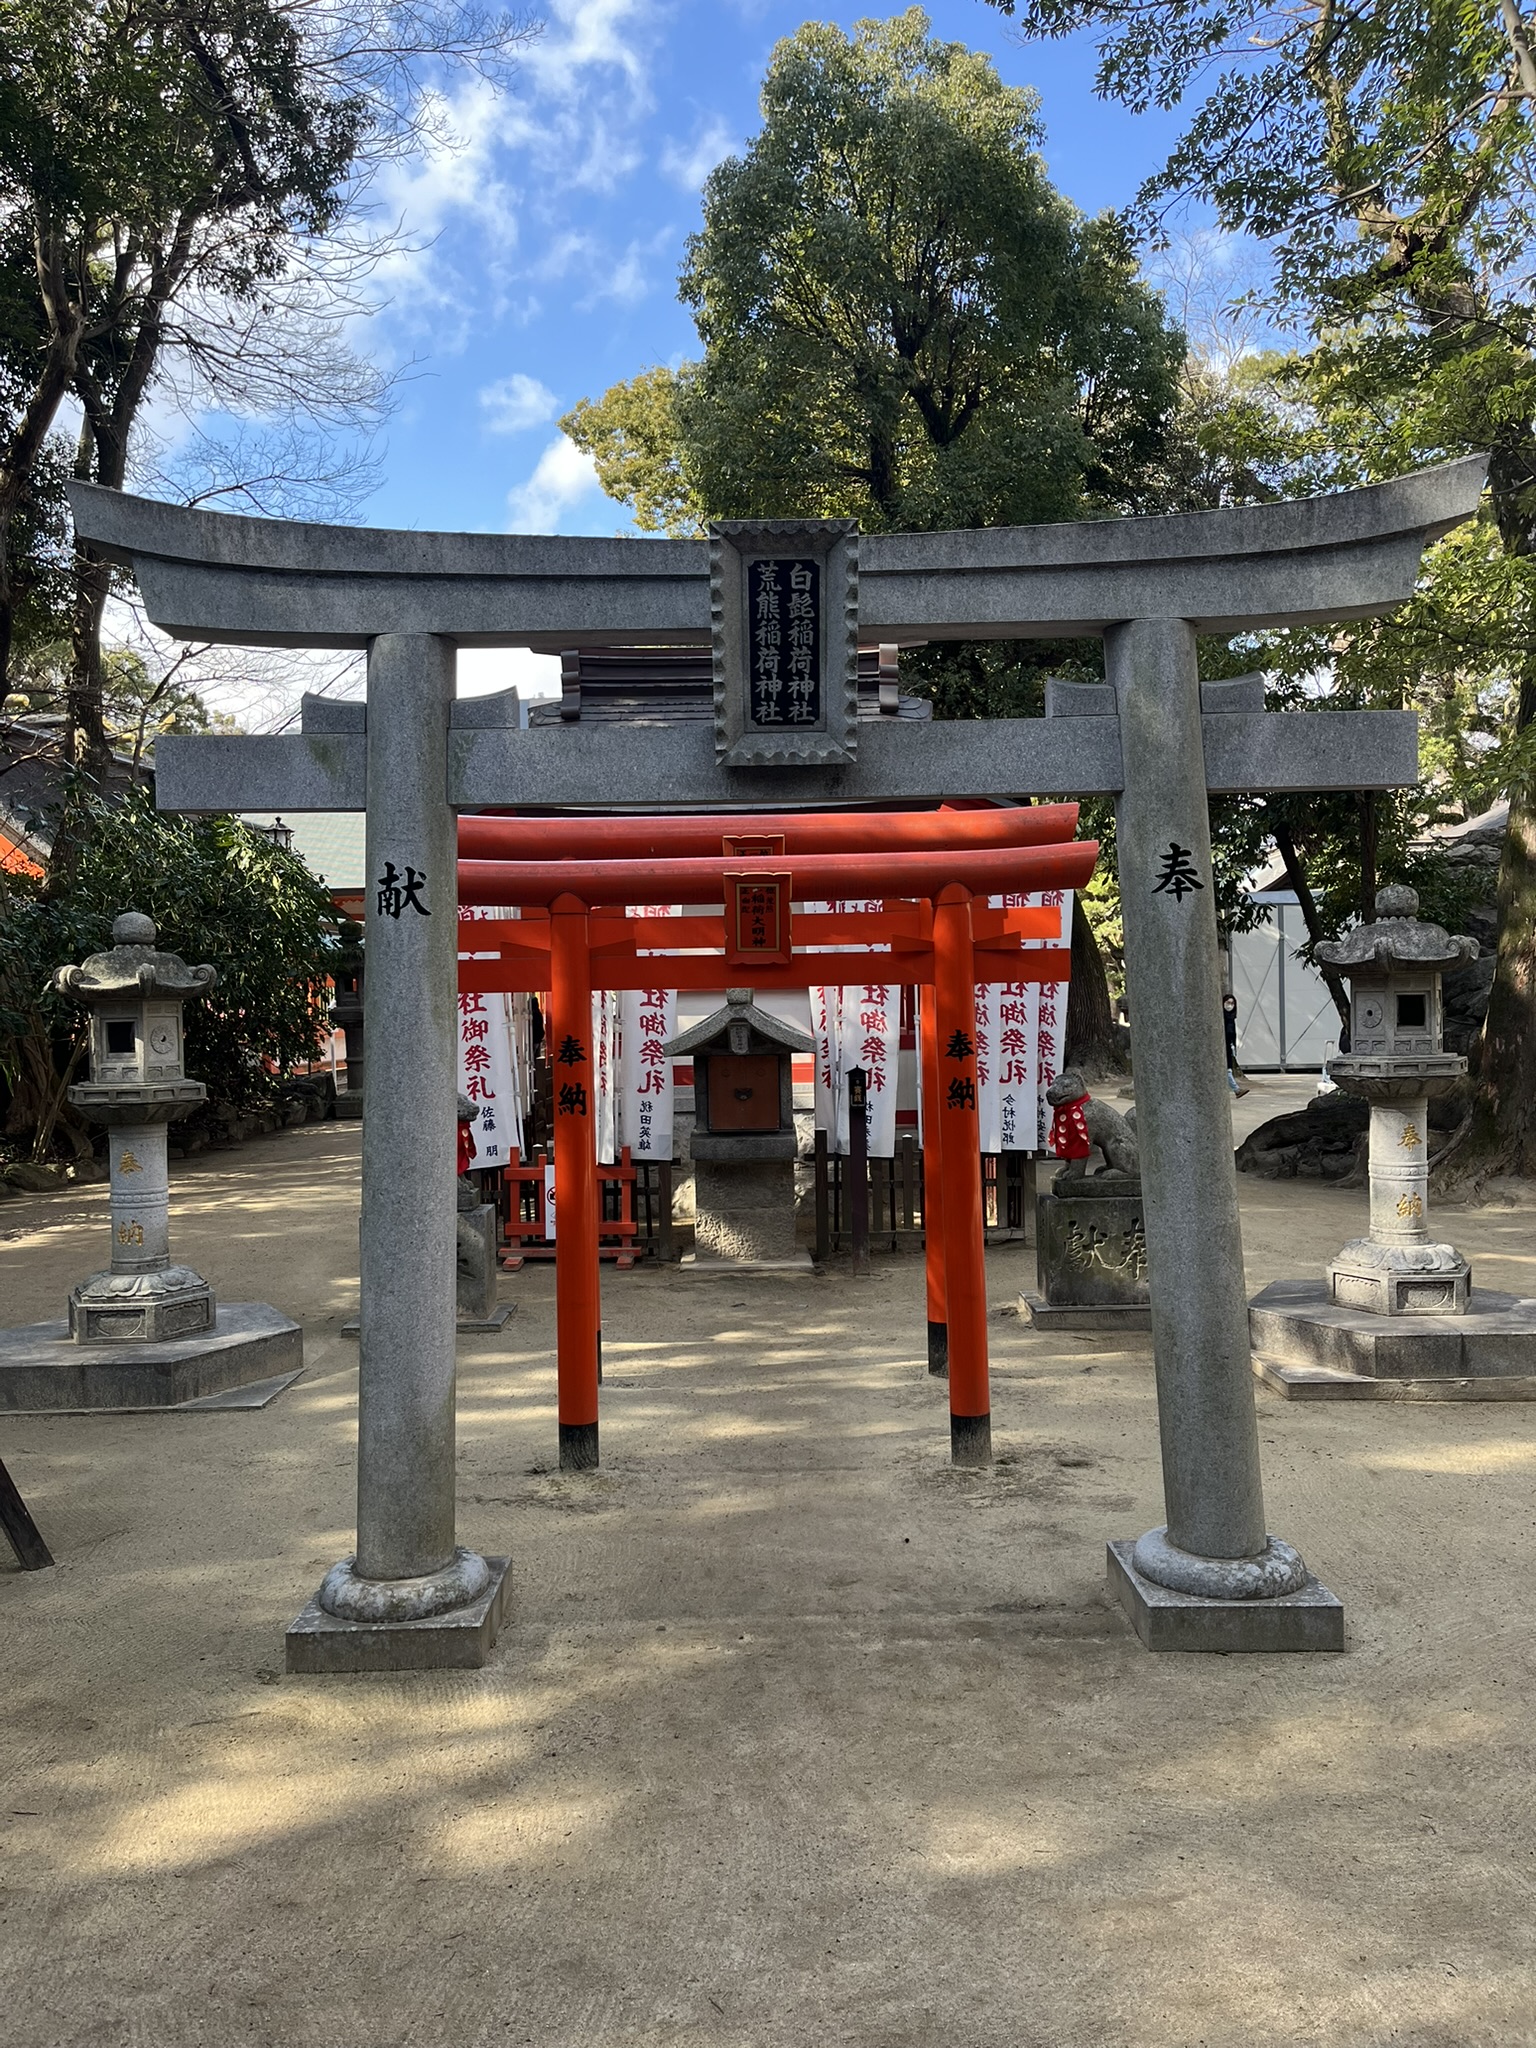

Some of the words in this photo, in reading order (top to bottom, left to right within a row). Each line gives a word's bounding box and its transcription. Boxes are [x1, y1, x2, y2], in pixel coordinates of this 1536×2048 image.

[755, 560, 783, 723] 荒熊稲荷神社
[787, 563, 815, 723] 白髭稲荷神社
[377, 861, 432, 920] 献
[1151, 842, 1205, 903] 奉
[557, 1034, 587, 1117] 奉納
[944, 1028, 975, 1112] 奉納
